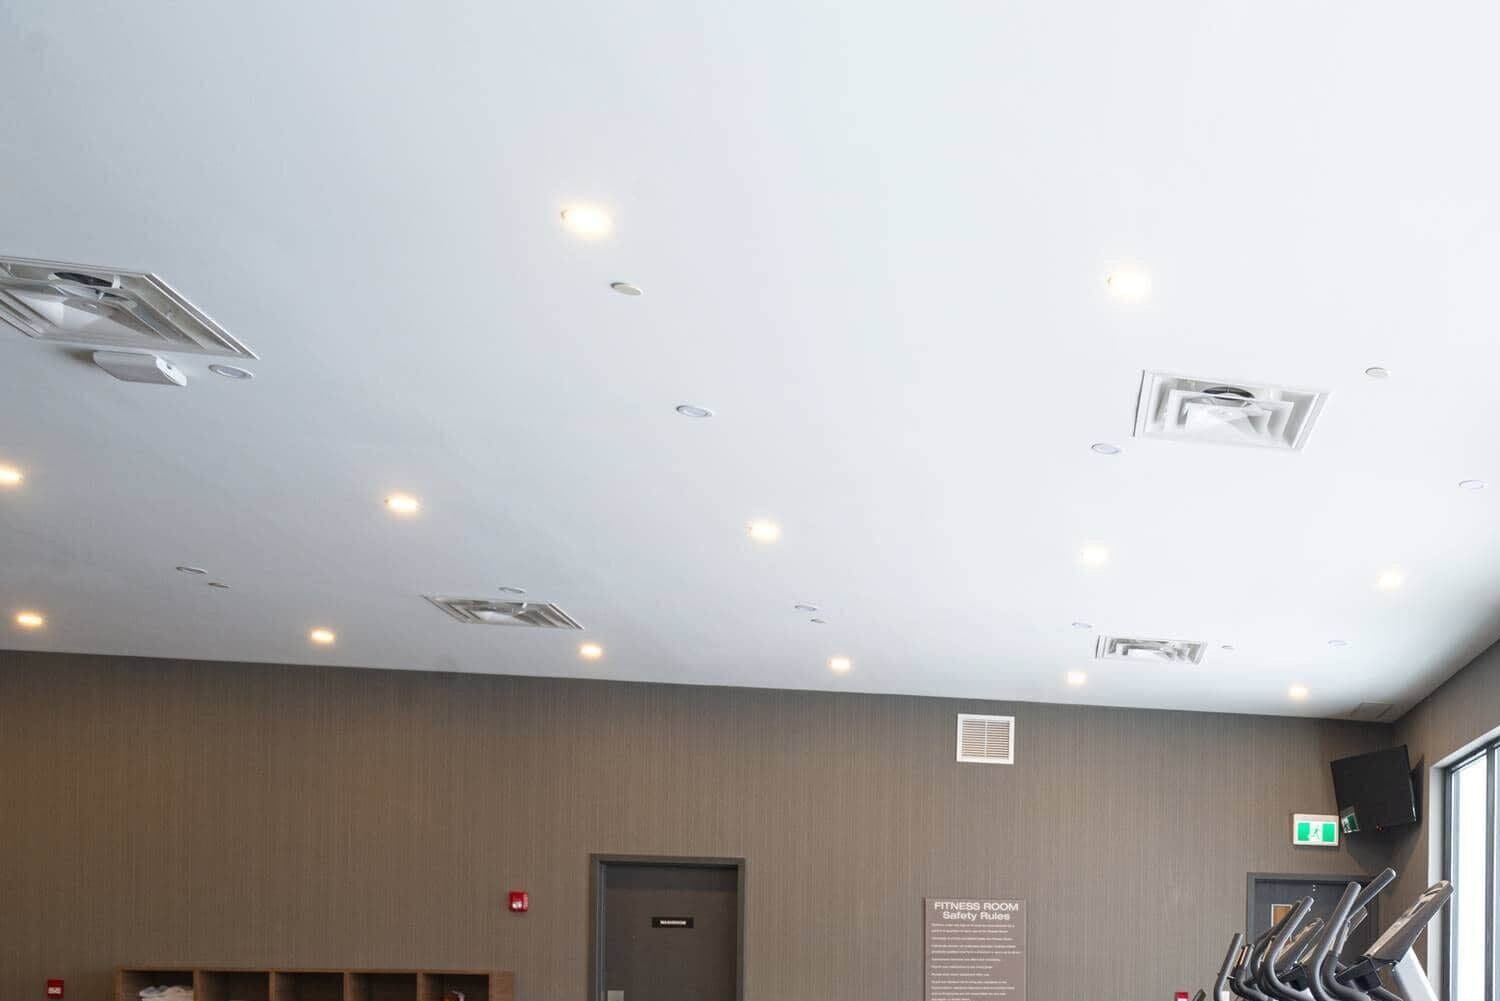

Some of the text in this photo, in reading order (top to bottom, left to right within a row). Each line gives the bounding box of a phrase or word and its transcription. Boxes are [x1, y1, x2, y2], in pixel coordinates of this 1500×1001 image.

[934, 901, 1019, 911] FITNESS ROOM
[942, 911, 1010, 921] Safety Rules
